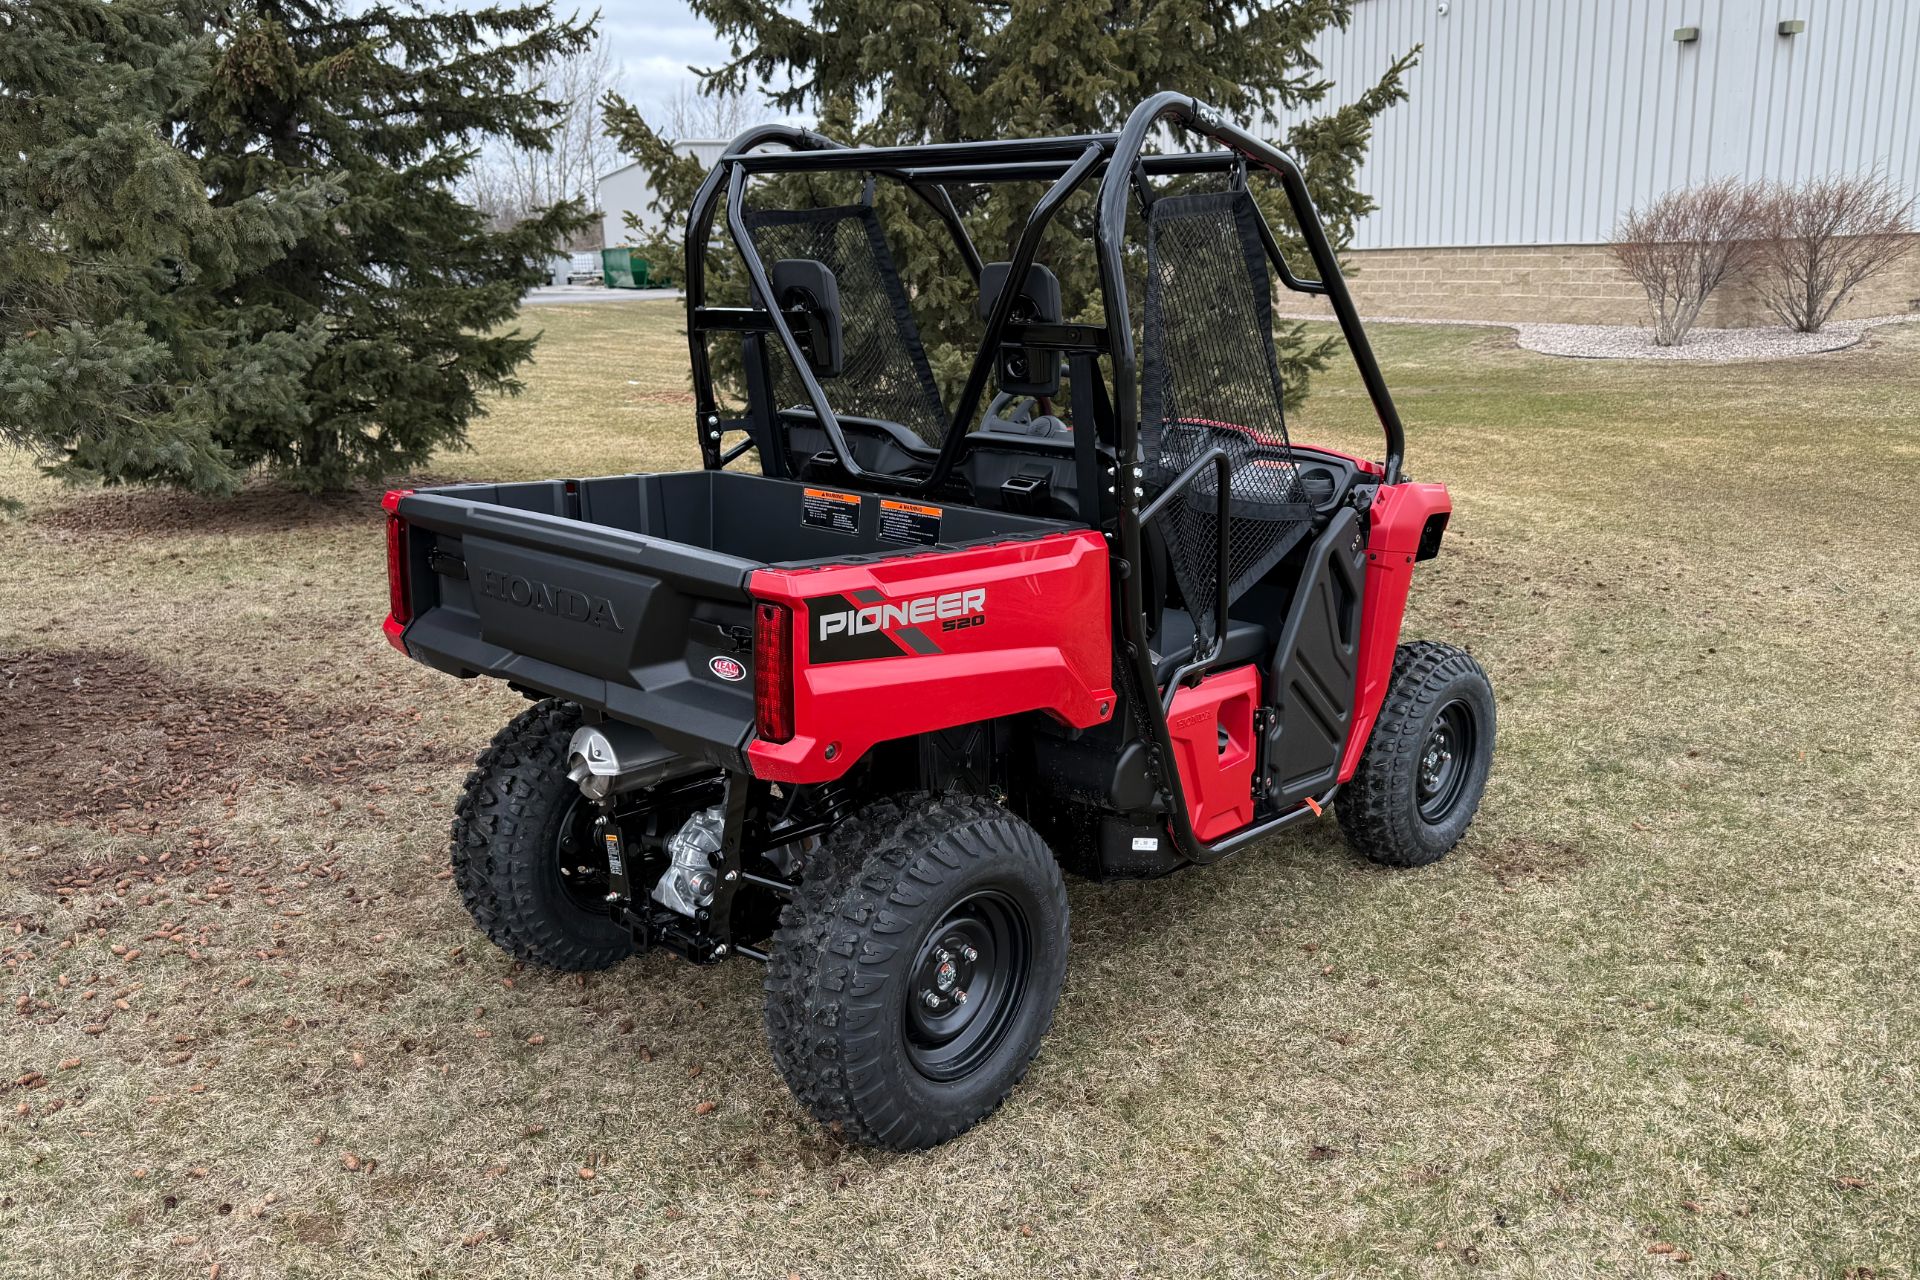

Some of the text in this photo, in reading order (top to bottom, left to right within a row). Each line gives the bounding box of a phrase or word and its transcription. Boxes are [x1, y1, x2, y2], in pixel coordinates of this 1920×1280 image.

[480, 567, 625, 634] HONDA
[819, 587, 986, 642] PIONEER
[942, 614, 985, 633] 520
